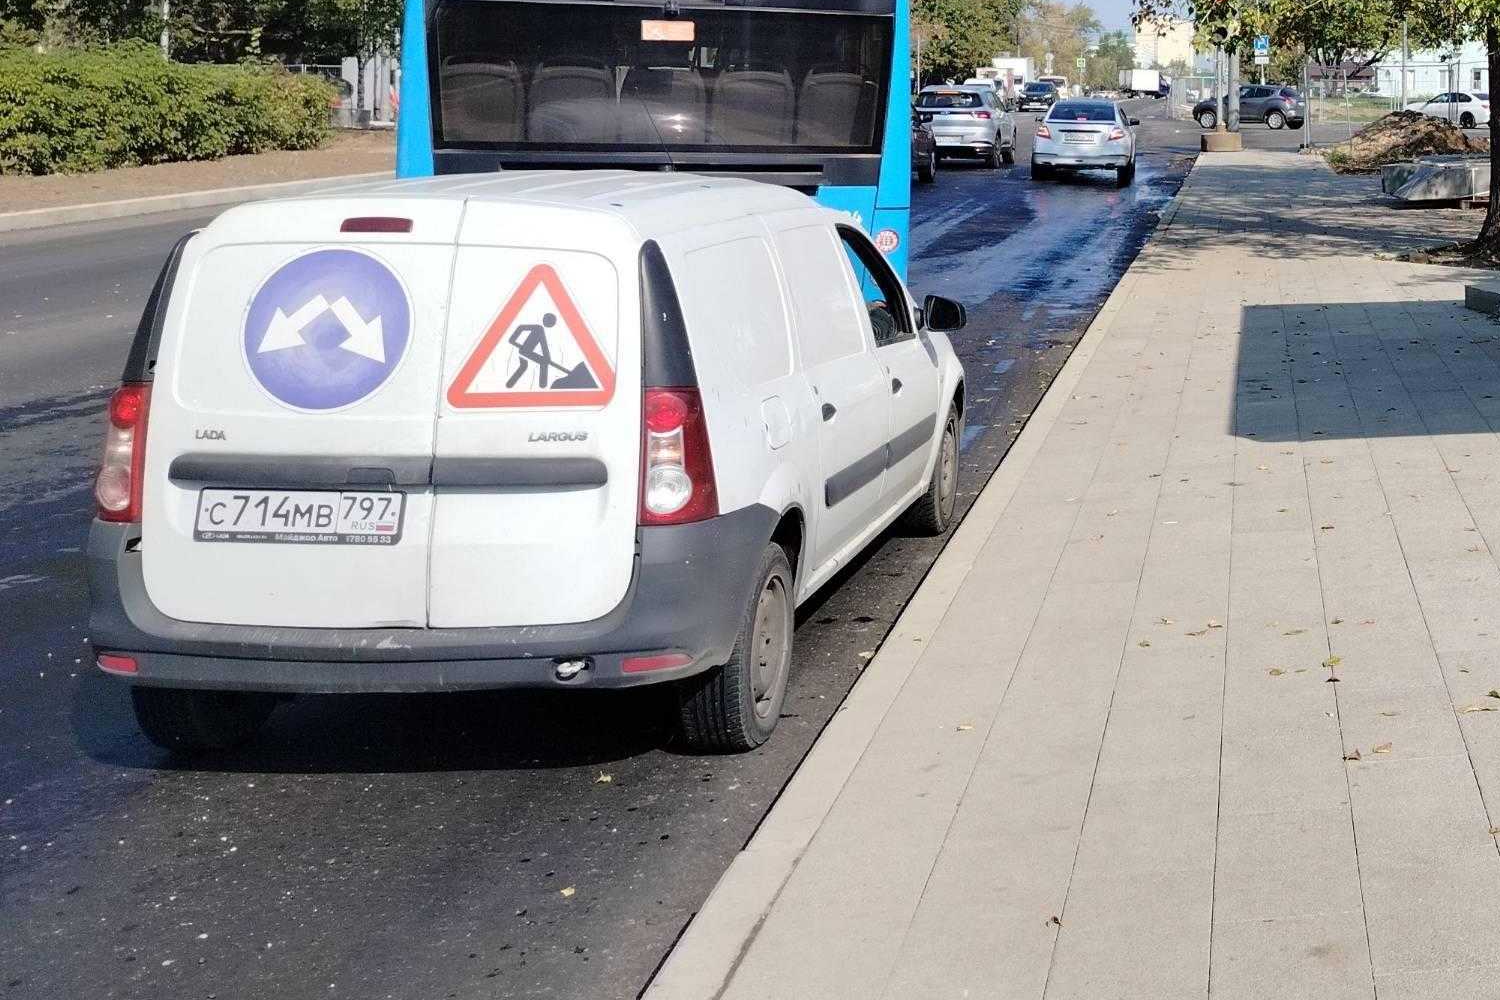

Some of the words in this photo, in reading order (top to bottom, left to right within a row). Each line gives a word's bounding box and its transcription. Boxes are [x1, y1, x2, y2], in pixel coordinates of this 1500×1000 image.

[195, 429, 226, 441] LADA
[527, 431, 588, 443] LARGUS
[209, 495, 333, 528] С714МВ
[343, 496, 392, 521] 797
[352, 520, 375, 530] RUS
